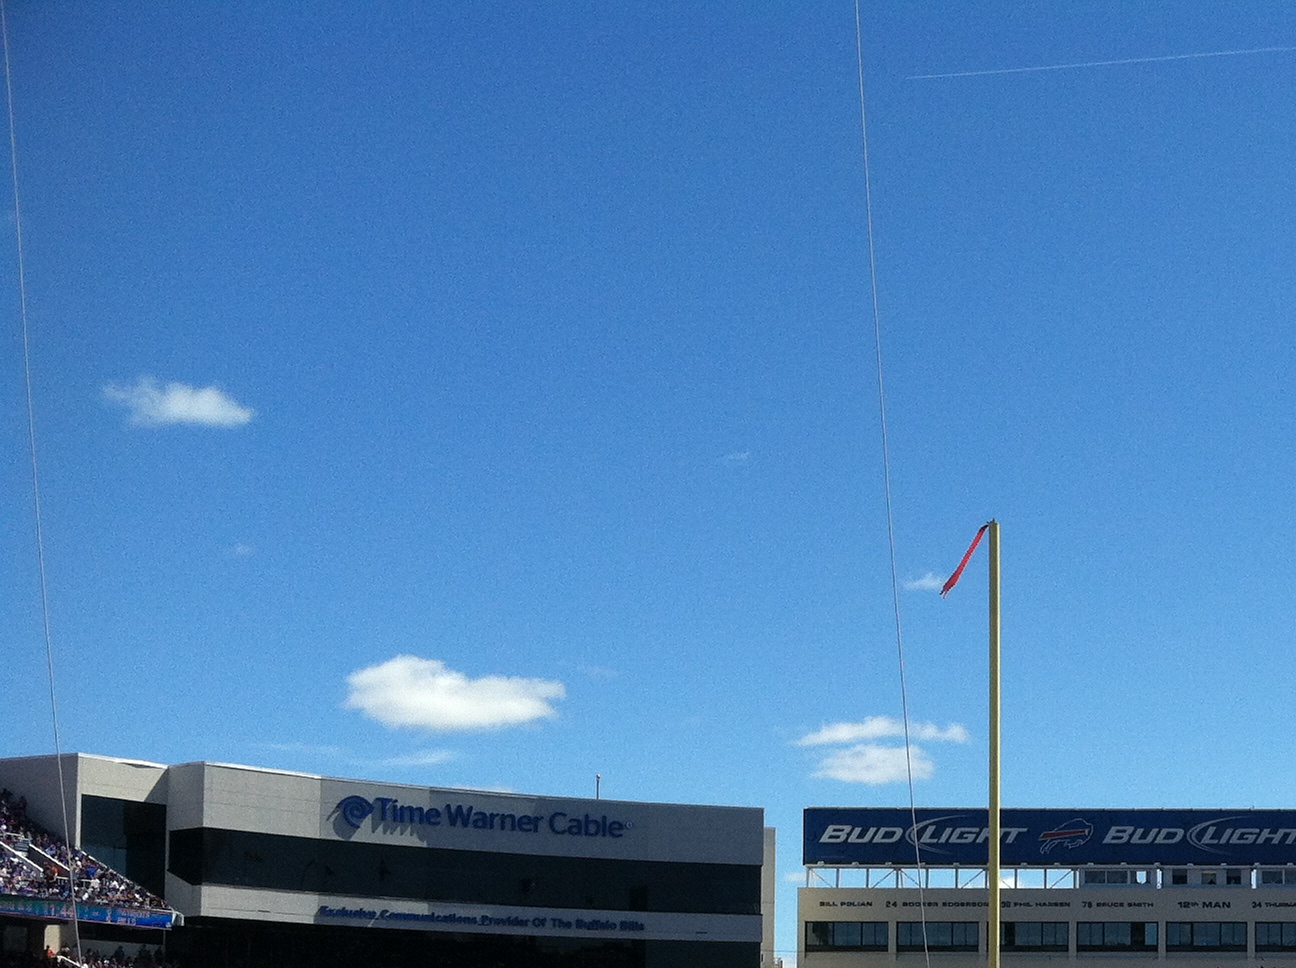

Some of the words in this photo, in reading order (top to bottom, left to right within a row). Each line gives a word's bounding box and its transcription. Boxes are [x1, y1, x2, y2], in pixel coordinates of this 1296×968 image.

[374, 797, 441, 826] Time
[445, 803, 544, 834] Warner
[549, 812, 625, 838] Cable
[1202, 901, 1231, 909] MAN
[550, 918, 573, 930] The
